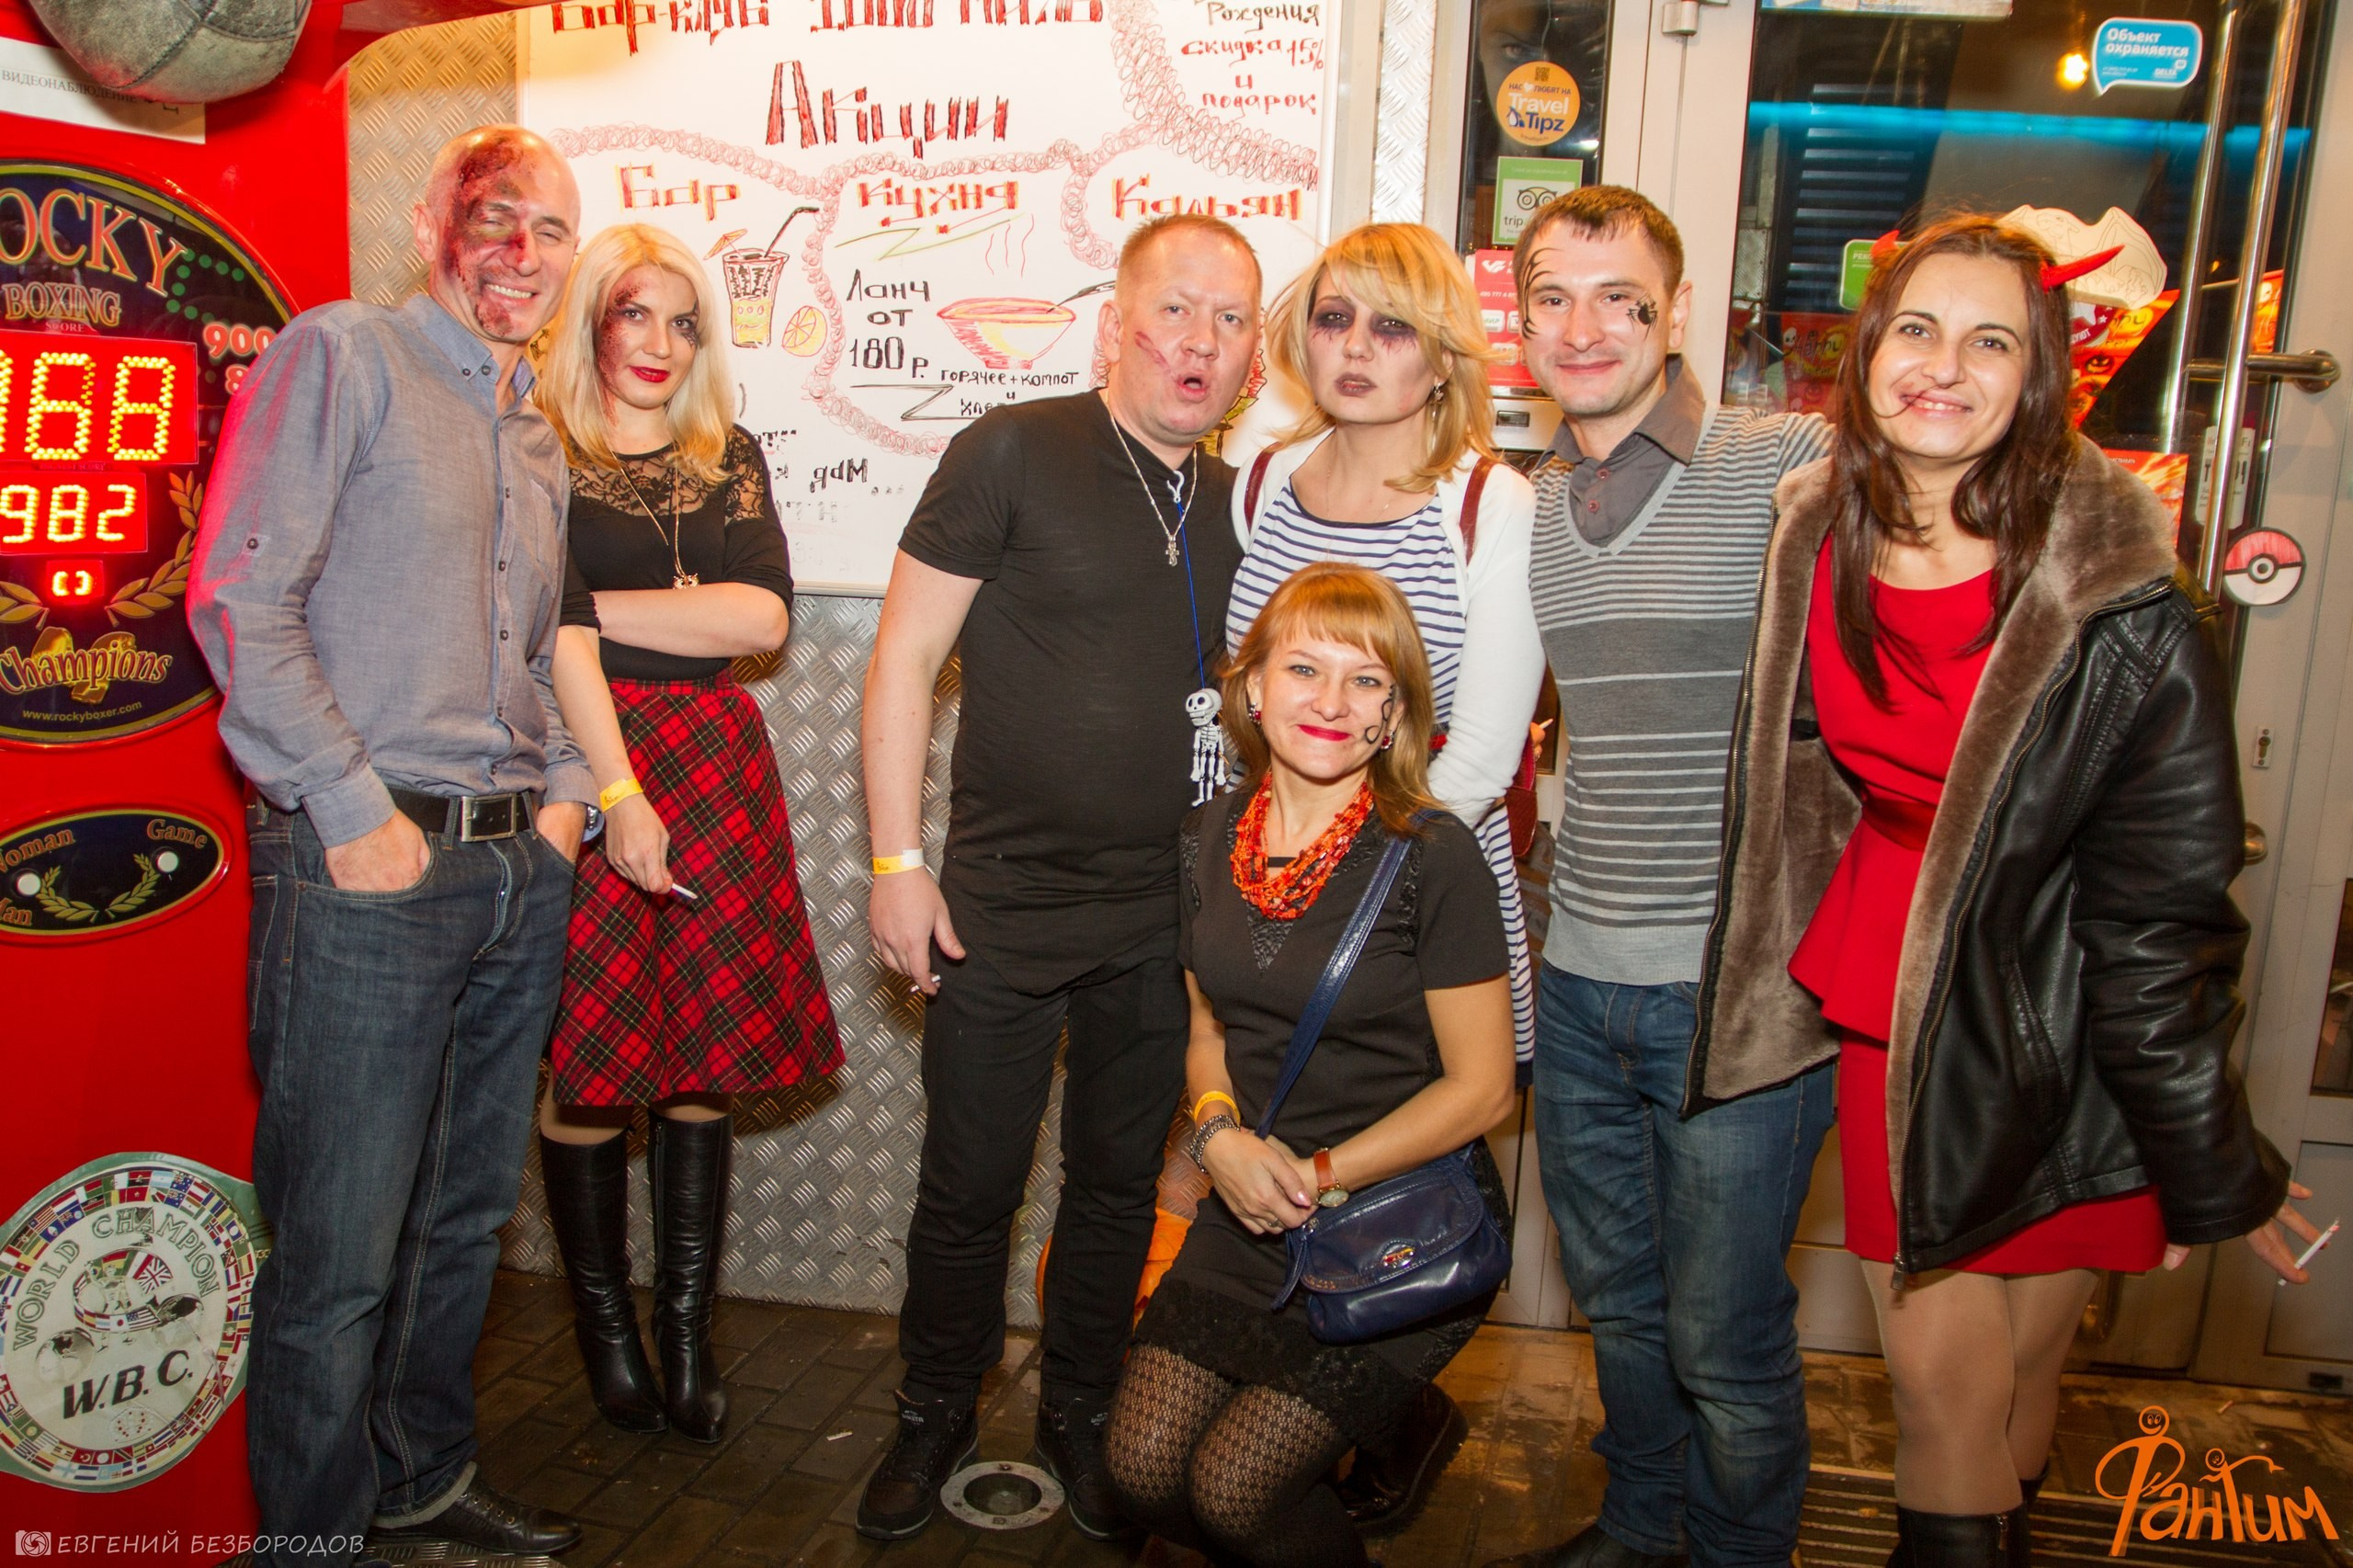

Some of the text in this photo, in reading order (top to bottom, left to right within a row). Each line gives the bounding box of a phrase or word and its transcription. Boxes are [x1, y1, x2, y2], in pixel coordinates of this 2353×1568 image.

[2105, 42, 2190, 57] охраняется
[2107, 28, 2162, 43] Объект
[1287, 37, 1324, 71] 15%
[766, 60, 1008, 160] Акции
[1202, 93, 1316, 121] подарок
[1508, 92, 1570, 115] Travel
[1526, 111, 1565, 134] Tipz
[616, 162, 741, 222] Бар
[1112, 174, 1302, 221] Кальян
[847, 268, 931, 301] Ланч
[2, 281, 121, 326] BOXING
[849, 336, 904, 369] 180
[0, 645, 173, 695] Champions
[23, 700, 142, 723] www.rockyboxer.com
[146, 819, 208, 849] Game
[13, 1207, 221, 1351] WORLD CHAMPION
